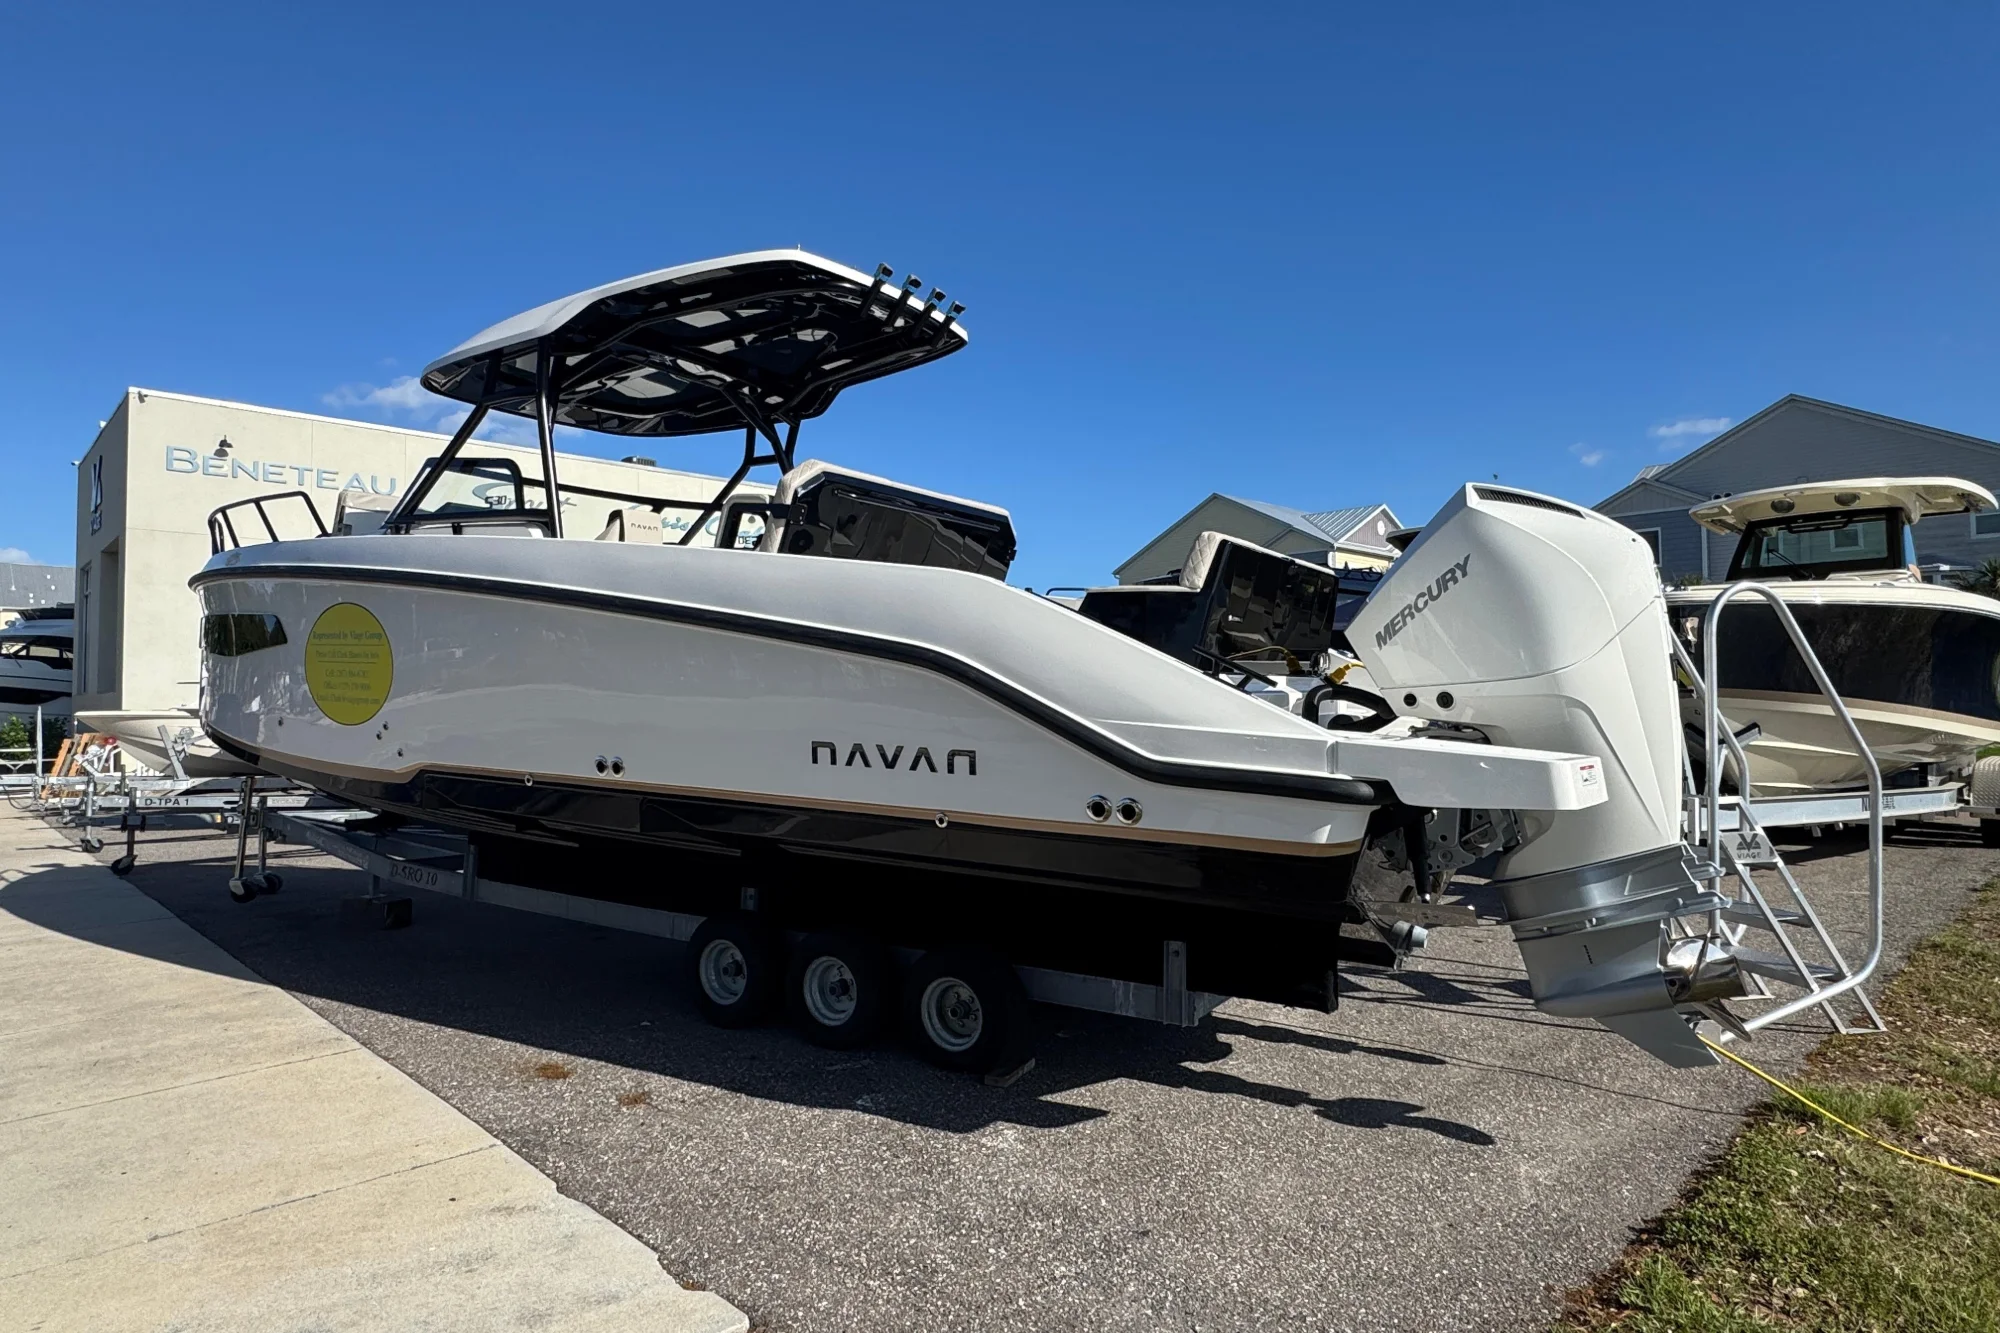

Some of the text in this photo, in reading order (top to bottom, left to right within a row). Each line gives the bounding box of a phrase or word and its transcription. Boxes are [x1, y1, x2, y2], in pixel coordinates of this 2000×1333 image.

[165, 445, 397, 496] BENETEAU
[1375, 552, 1471, 651] MERCURY
[811, 740, 977, 776] NAVAN
[144, 798, 189, 806] D-TPA 1
[1737, 851, 1762, 859] VIAGE
